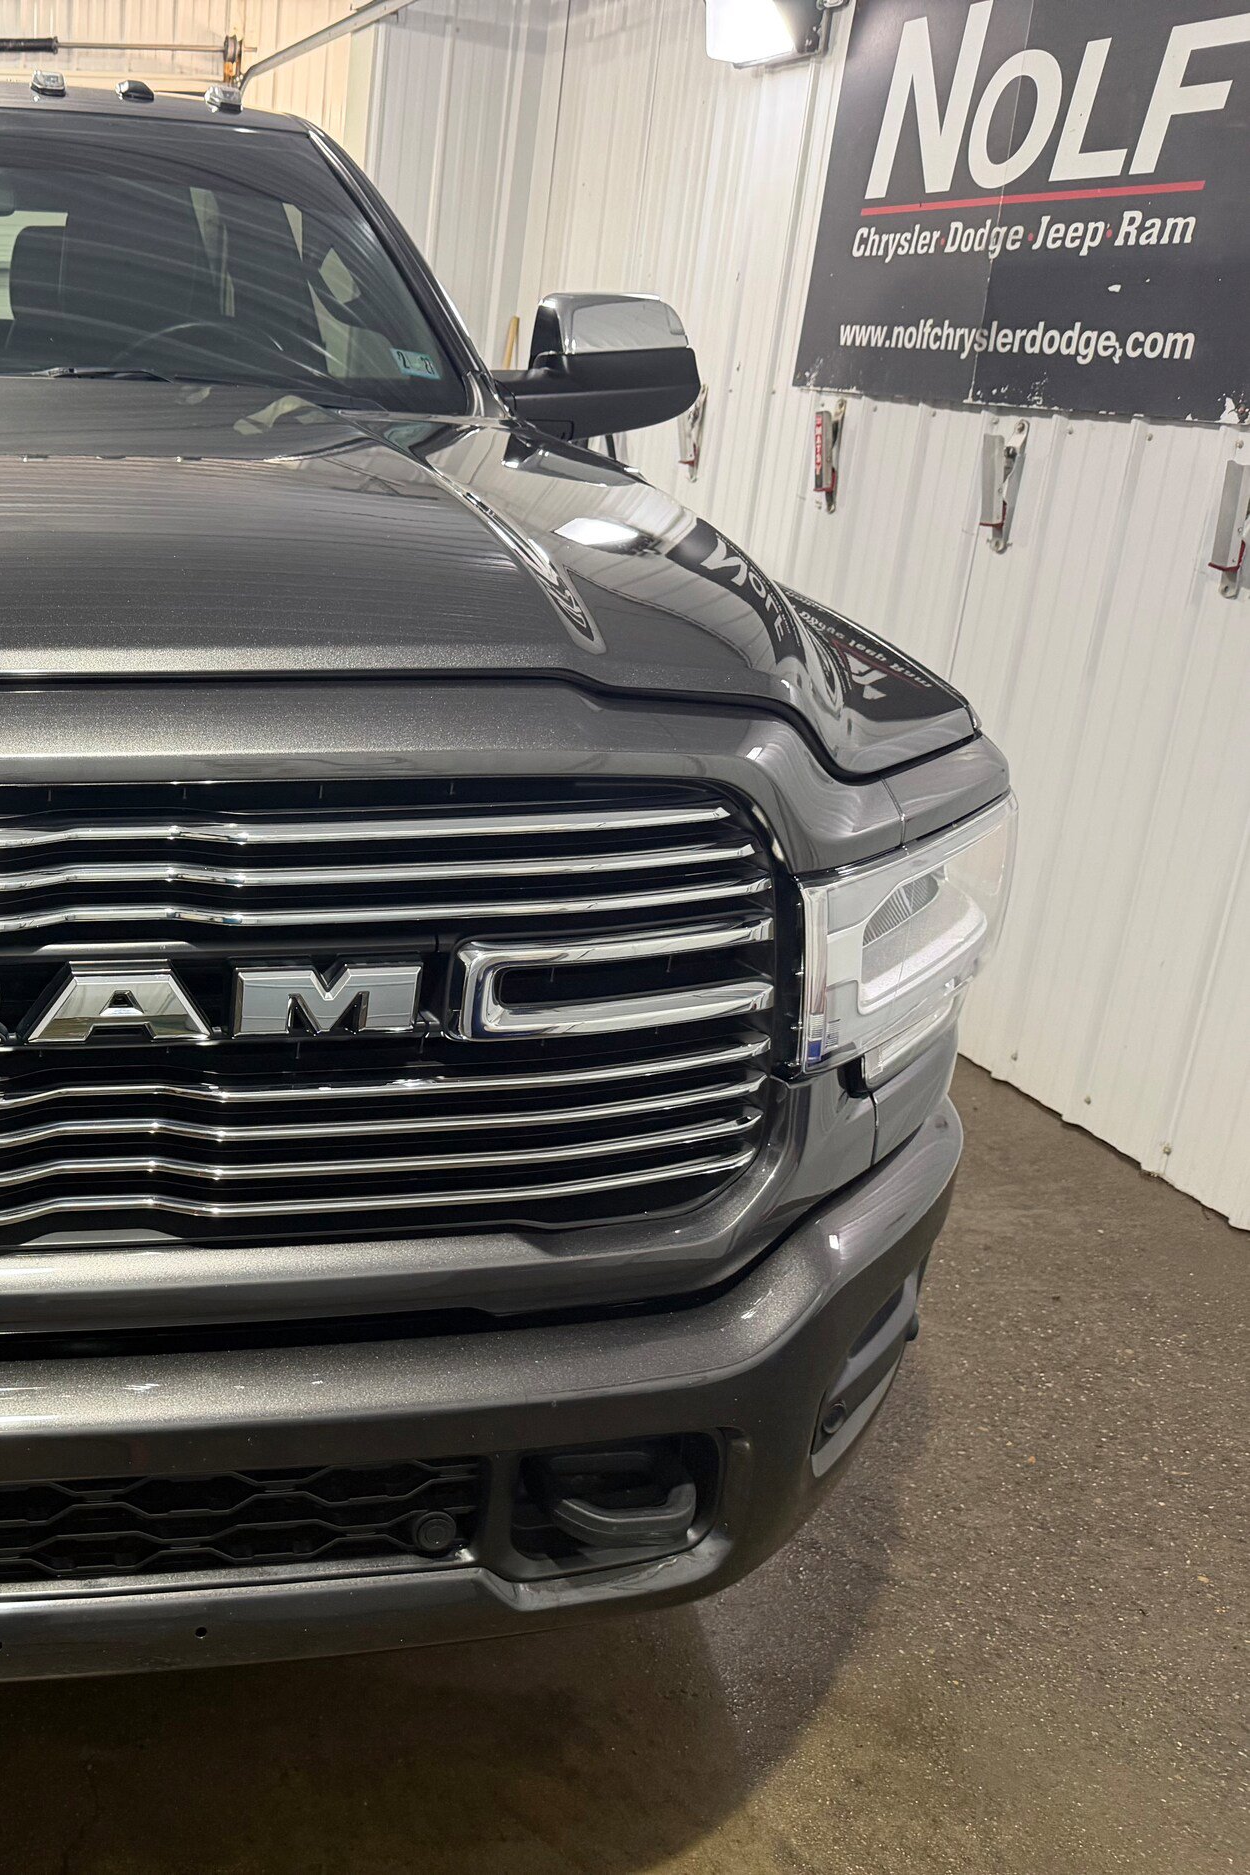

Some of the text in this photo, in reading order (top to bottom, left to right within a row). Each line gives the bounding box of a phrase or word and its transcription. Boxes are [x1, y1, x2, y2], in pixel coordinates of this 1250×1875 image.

[864, 0, 1250, 200] NOLF
[851, 210, 1197, 263] Chrysler Dodge Jeep Ram
[839, 318, 1196, 365] www.nolfchryslerdodge.com
